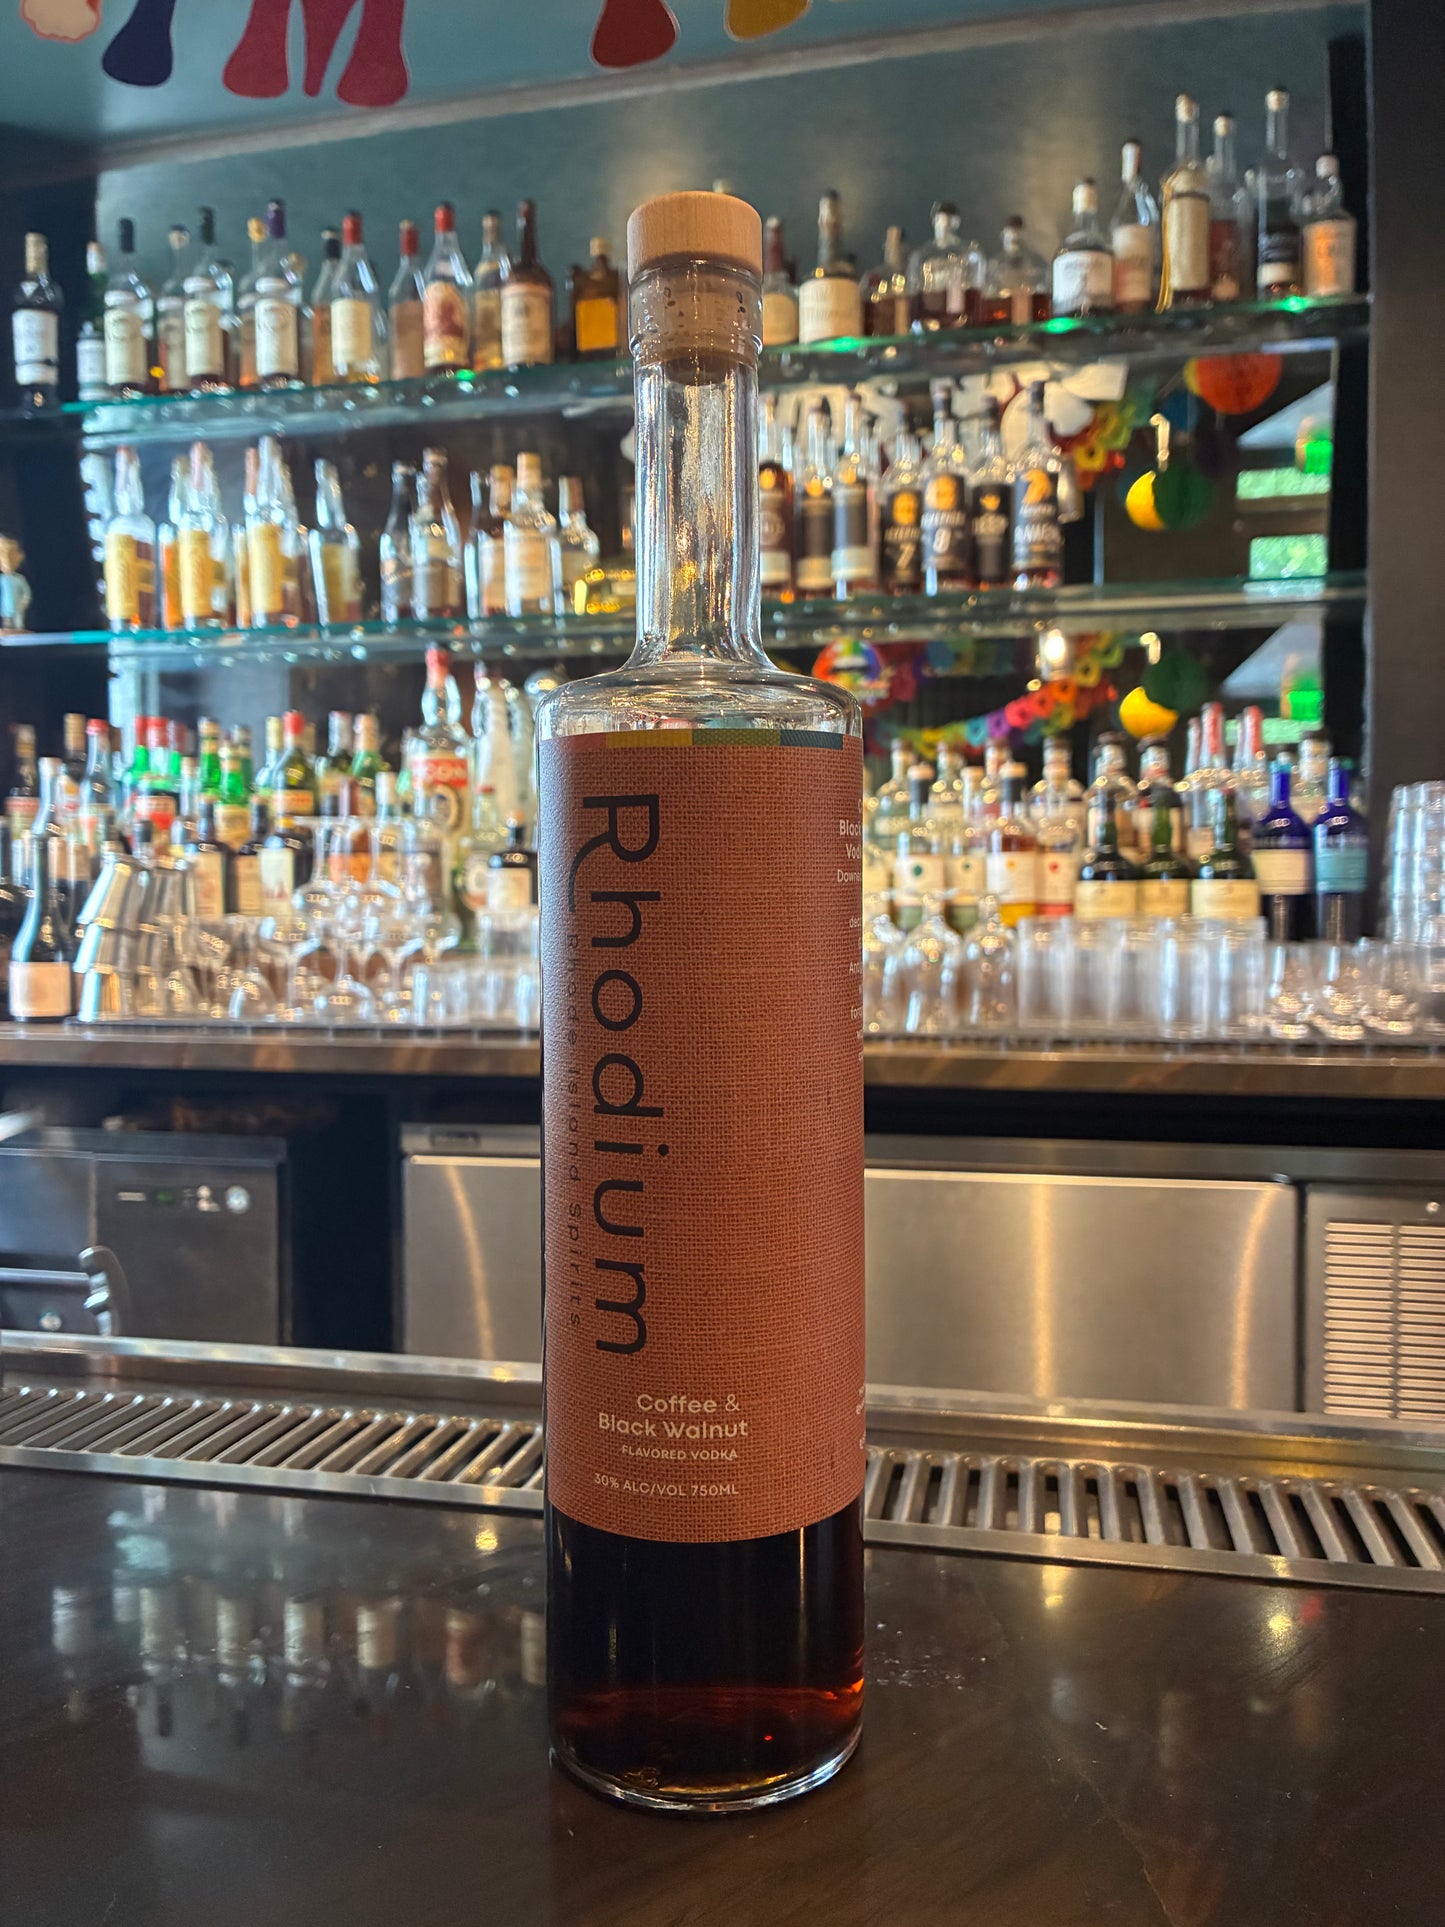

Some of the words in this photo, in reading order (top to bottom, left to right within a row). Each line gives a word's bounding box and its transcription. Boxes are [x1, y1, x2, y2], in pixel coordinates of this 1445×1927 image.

[566, 933, 581, 1047] Rhode
[568, 794, 669, 1355] Rhodium
[567, 1066, 582, 1182] Island
[567, 1203, 583, 1327] Spirits
[598, 1412, 657, 1437] Black
[662, 1418, 749, 1440] Walnut
[636, 1393, 718, 1414] Coffee
[724, 1393, 741, 1412] &
[594, 1472, 620, 1489] 30%
[623, 1481, 688, 1497] ALC/VOL
[691, 1483, 740, 1498] 750ML
[621, 1444, 687, 1460] FLAVORED
[690, 1448, 739, 1461] VODKA
